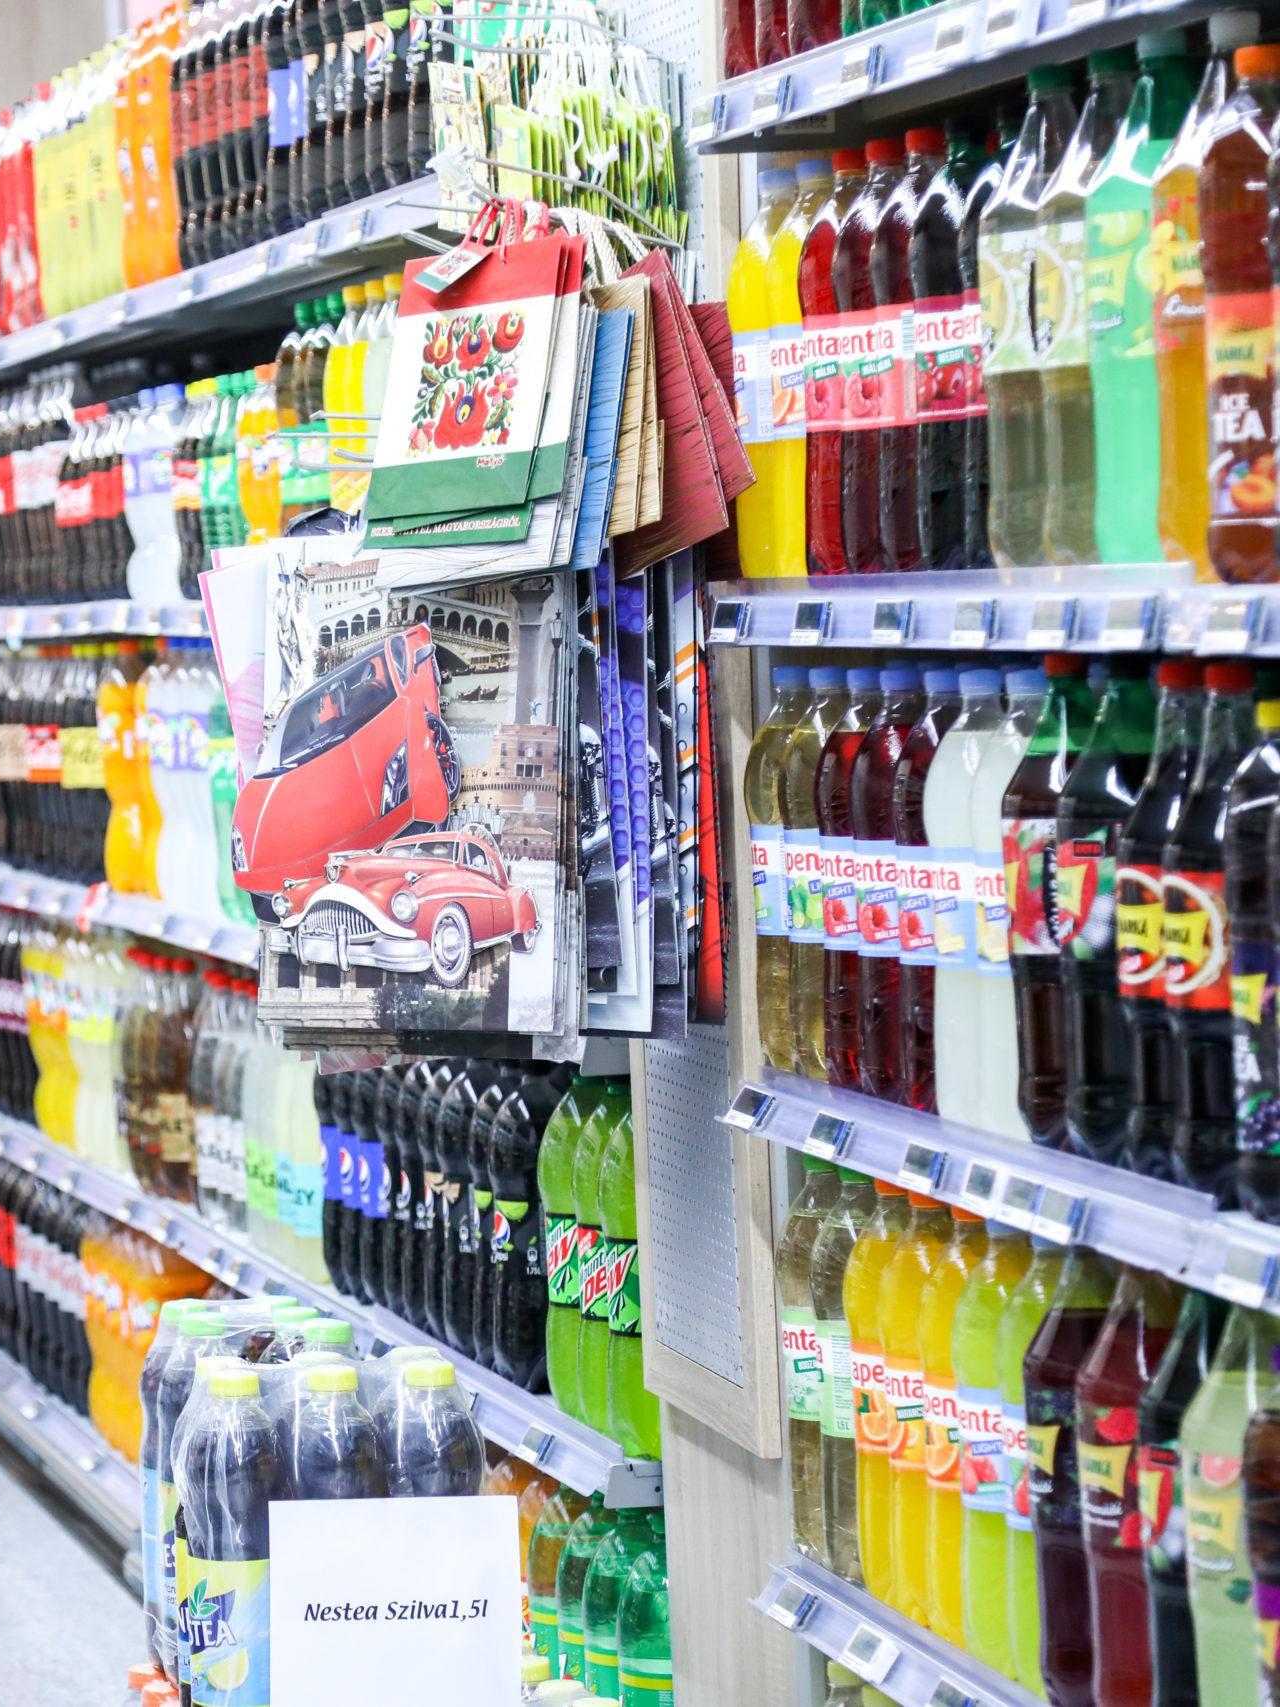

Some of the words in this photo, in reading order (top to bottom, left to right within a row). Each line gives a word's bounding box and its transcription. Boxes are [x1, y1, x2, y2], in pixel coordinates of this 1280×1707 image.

[1220, 393, 1250, 411] ICE
[1213, 410, 1267, 443] TEA
[432, 515, 521, 535] MAGYARORSZÁGRÓL
[827, 884, 853, 898] LIGHT
[867, 888, 895, 905] LIGHT
[903, 895, 929, 912] LIGHT
[972, 1440, 1003, 1456] LIGHT
[304, 1602, 379, 1622] Nestea
